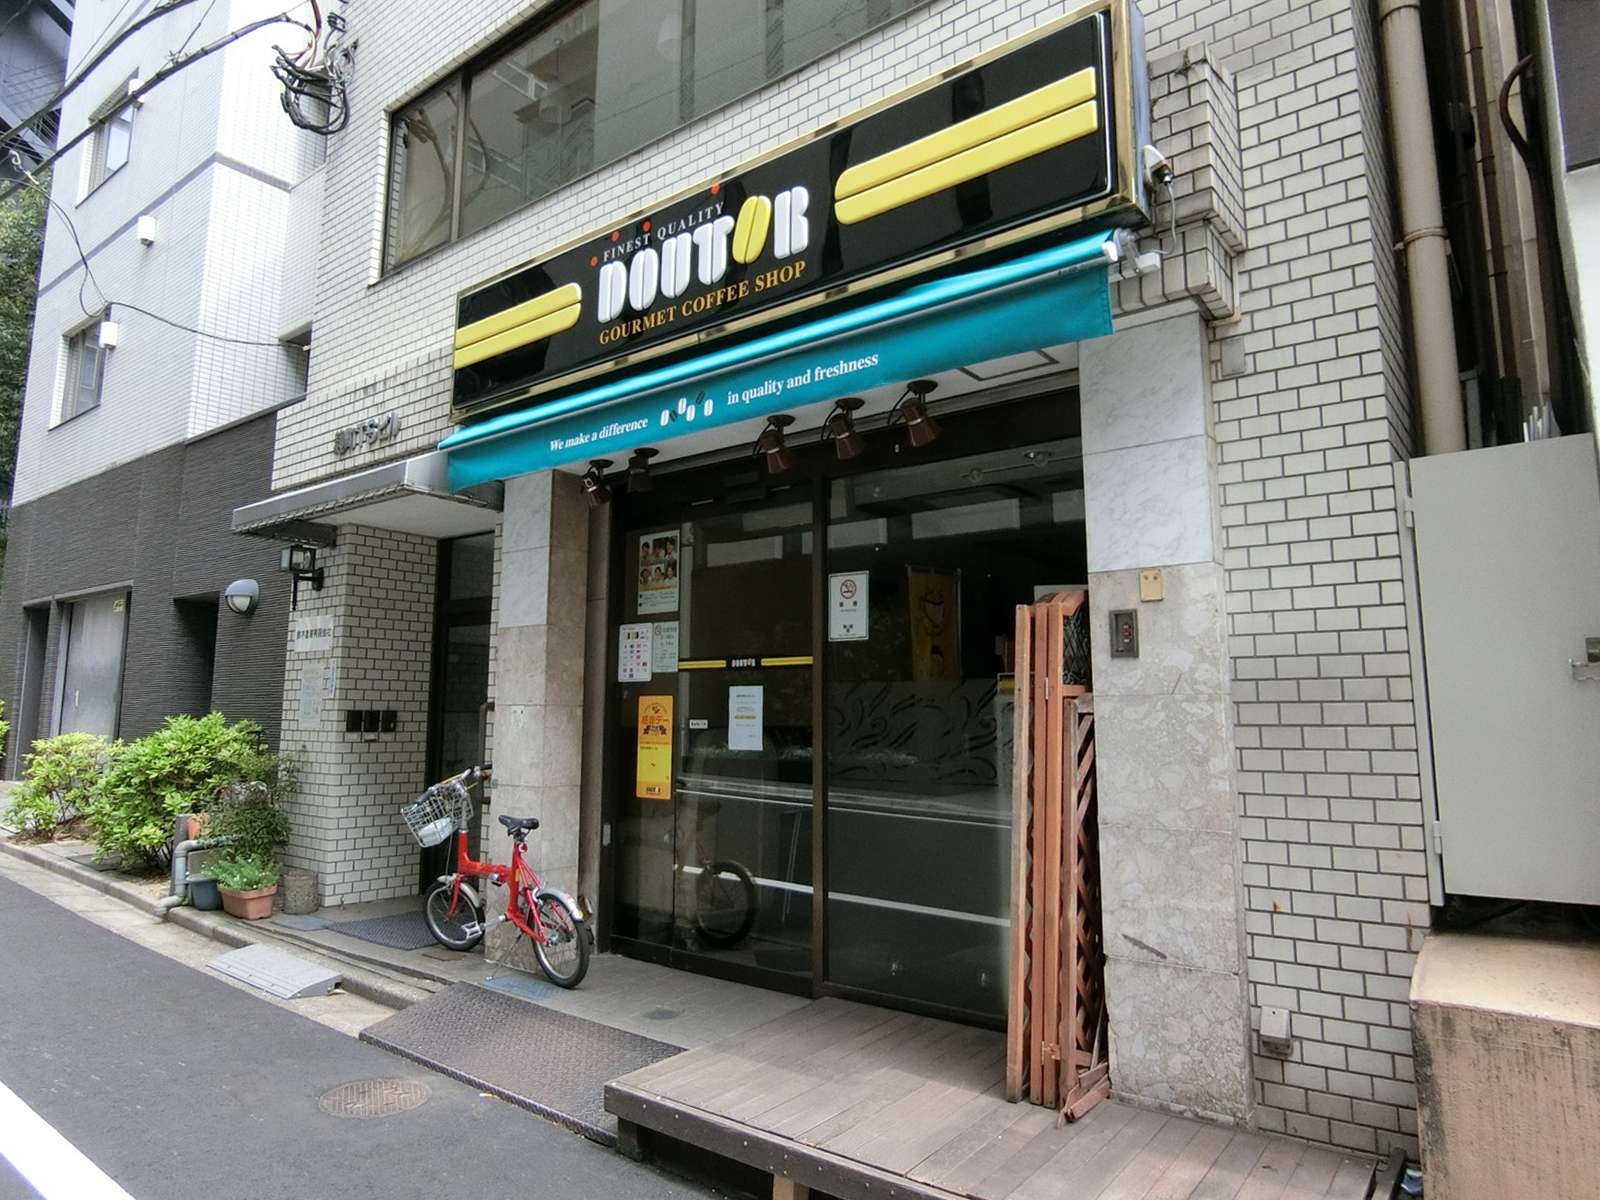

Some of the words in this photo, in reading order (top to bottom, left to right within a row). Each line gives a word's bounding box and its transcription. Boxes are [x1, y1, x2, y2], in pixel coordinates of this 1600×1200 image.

[598, 186, 809, 324] DOUTOR
[603, 233, 650, 262] FINEST
[657, 202, 723, 240] QUALITY
[600, 306, 677, 345] GOURMET
[682, 280, 749, 317] COFFEE
[755, 260, 806, 292] SHOP
[550, 439, 564, 451] We
[565, 433, 590, 448] make
[591, 432, 597, 441] a
[599, 418, 648, 439] difference
[727, 391, 739, 405] in
[742, 379, 783, 404] quality
[787, 369, 811, 389] and
[814, 354, 879, 382] freshness
